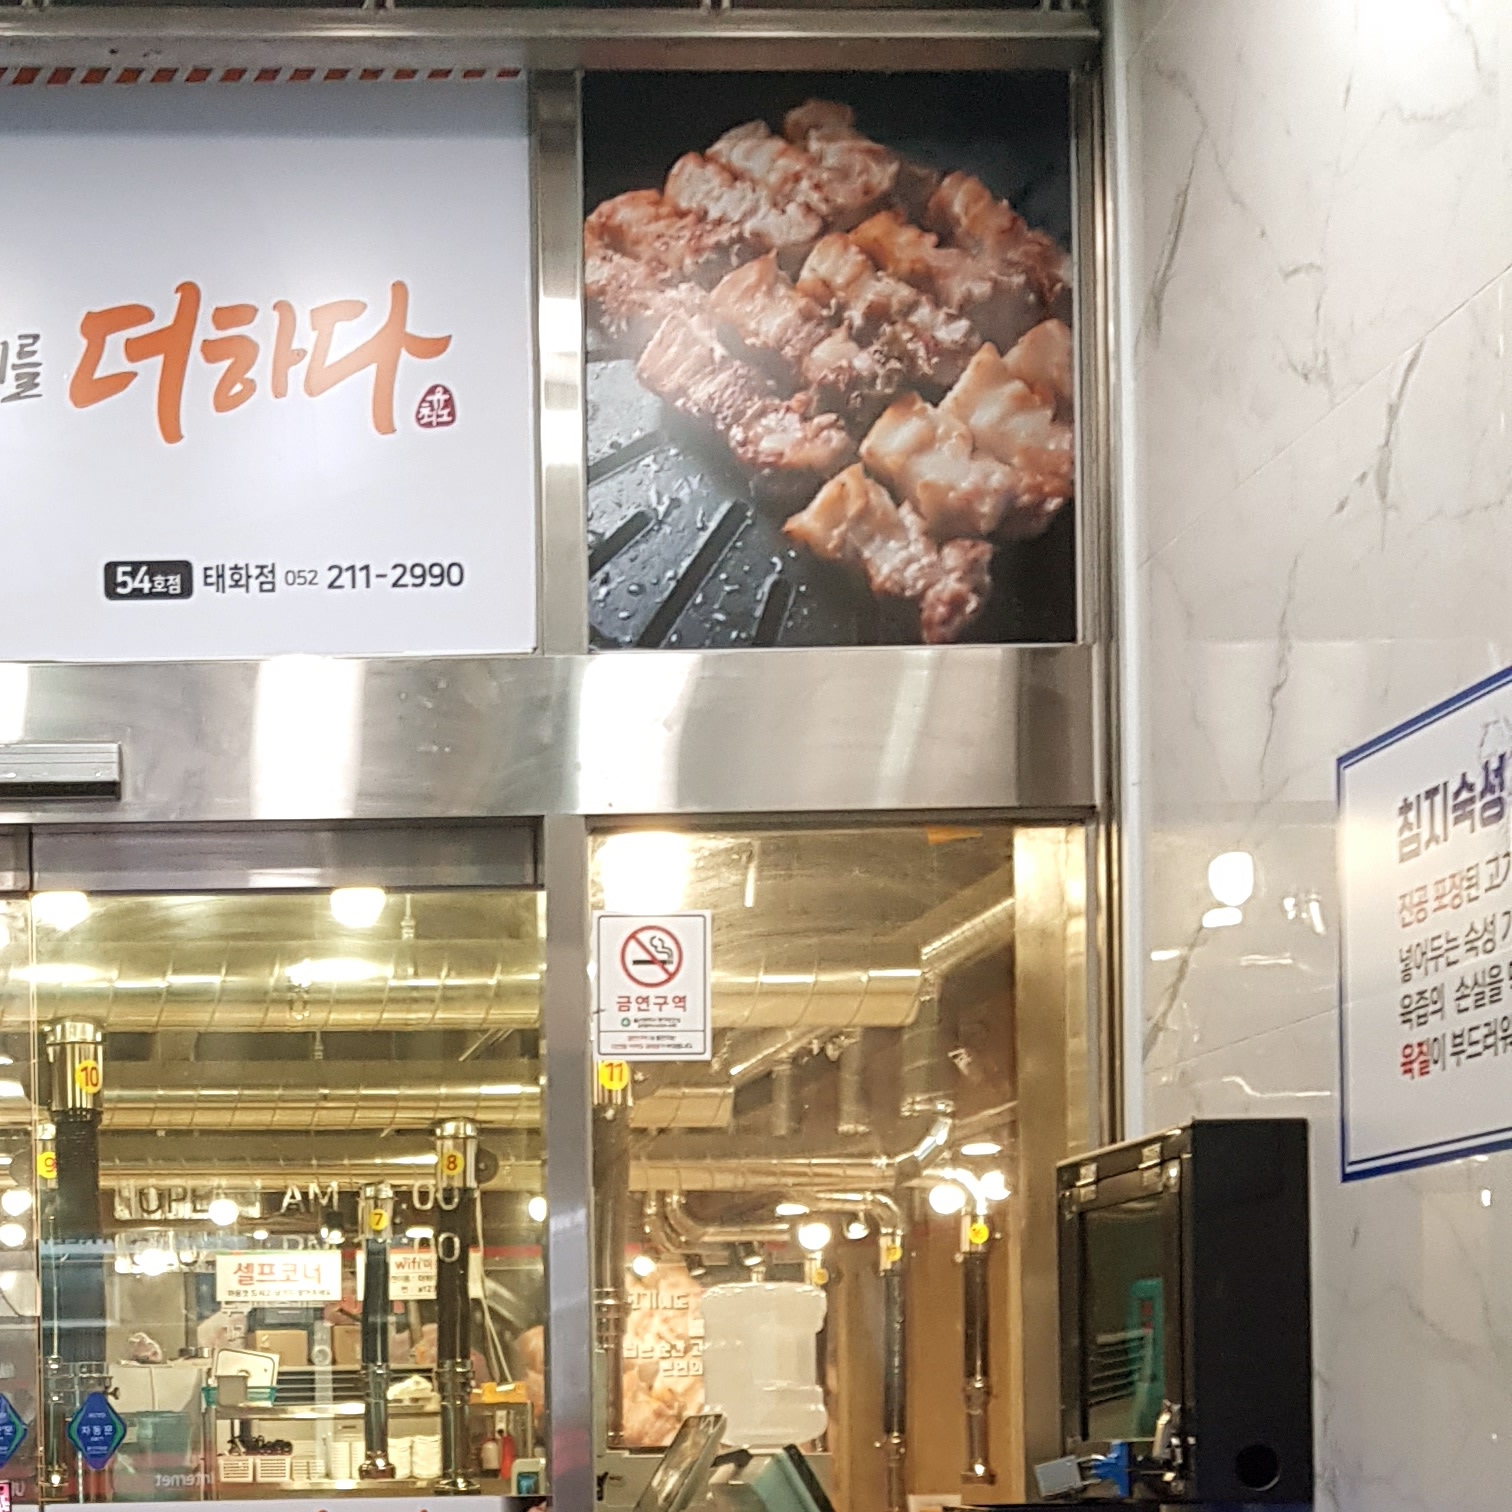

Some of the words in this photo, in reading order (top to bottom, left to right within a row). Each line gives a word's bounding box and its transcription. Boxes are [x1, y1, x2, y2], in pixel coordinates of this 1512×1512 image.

[69, 280, 452, 444] 더하다
[203, 562, 276, 594] 태화점
[284, 569, 319, 586] 052
[327, 562, 464, 590] 211-2990
[1433, 863, 1480, 912] 포장된
[1464, 913, 1497, 957] 숙성
[1454, 964, 1504, 1014] 손실을
[616, 995, 687, 1013] 금연구역
[1400, 1032, 1446, 1080] 육질이
[81, 1066, 99, 1087] 10
[605, 1062, 623, 1083] 11
[446, 1154, 458, 1171] 8
[373, 1212, 384, 1226] 7
[232, 1263, 321, 1286] 셀프코너
[81, 1425, 113, 1436] 자동문
